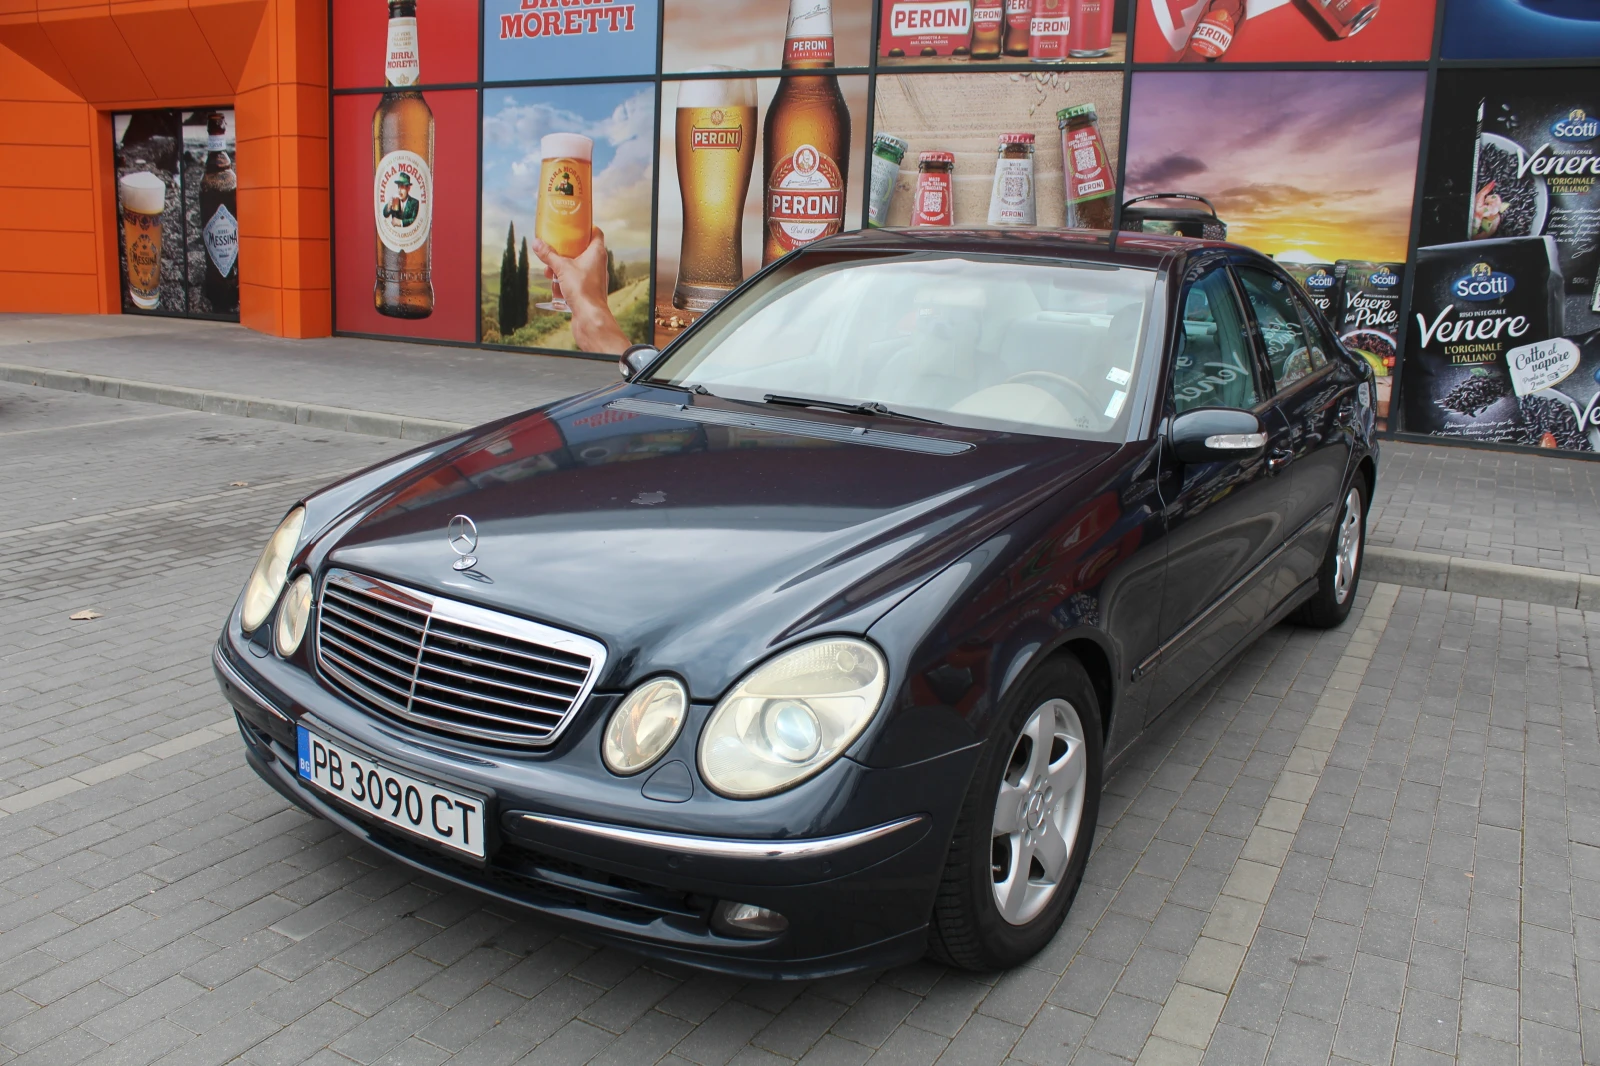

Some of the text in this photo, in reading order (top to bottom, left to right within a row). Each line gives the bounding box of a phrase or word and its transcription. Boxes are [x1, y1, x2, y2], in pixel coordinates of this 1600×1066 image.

[1006, 0, 1032, 10] PERO
[895, 8, 967, 29] PERONI
[973, 9, 1001, 19] PERONI
[500, 5, 635, 39] MORETTI
[1031, 20, 1069, 32] PERONI
[1196, 26, 1230, 48] PERONI
[793, 40, 827, 51] PERONI
[391, 51, 414, 60] BIRRA
[387, 59, 418, 68] MORETTI
[1554, 122, 1597, 137] Scotti
[695, 132, 739, 144] PERONI
[1517, 142, 1600, 179] Venere
[380, 163, 426, 204] BIRRA MORETTI
[548, 168, 562, 192] BIRRA
[1079, 181, 1104, 193] PERONI
[1547, 177, 1596, 186] L'ORIGINALE
[1552, 185, 1590, 193] ITALIANO
[772, 195, 838, 215] PERONI
[208, 229, 238, 247] MESSINA
[132, 253, 158, 268] MESSINA
[1308, 277, 1332, 287] Scotti
[1371, 275, 1396, 285] Scotti
[1457, 276, 1508, 297] Scotti
[1346, 290, 1392, 310] Venere
[1345, 307, 1398, 327] for Poke
[1474, 309, 1507, 317] INTEGRALE
[1416, 304, 1530, 349] Venere
[1444, 342, 1503, 355] L'ORIGINALE
[1452, 352, 1497, 363] ITALIANO
[1516, 343, 1557, 371] Cotto al
[1532, 351, 1570, 372] vapore
[1531, 381, 1536, 391] 2
[300, 757, 310, 773] BG
[313, 740, 475, 845] PB 3090 CT
